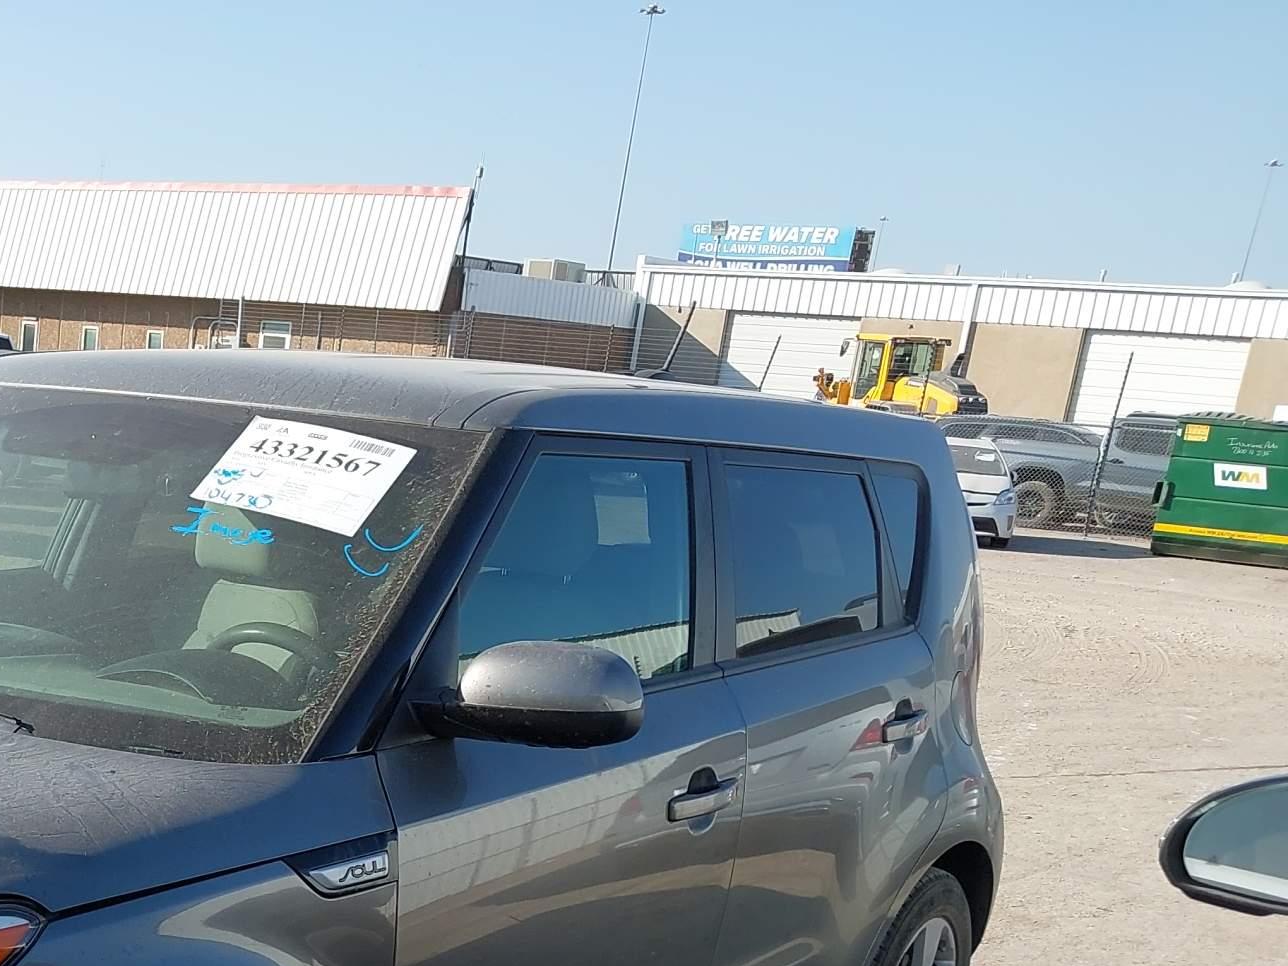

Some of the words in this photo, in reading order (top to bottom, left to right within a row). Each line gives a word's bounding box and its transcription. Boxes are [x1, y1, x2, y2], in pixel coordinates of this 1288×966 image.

[768, 226, 839, 245] WATER
[723, 243, 755, 255] LAWN
[758, 245, 825, 256] IRRIGATION
[249, 438, 381, 476] 43321567
[1221, 470, 1260, 483] WM
[339, 860, 387, 883] SOUL
